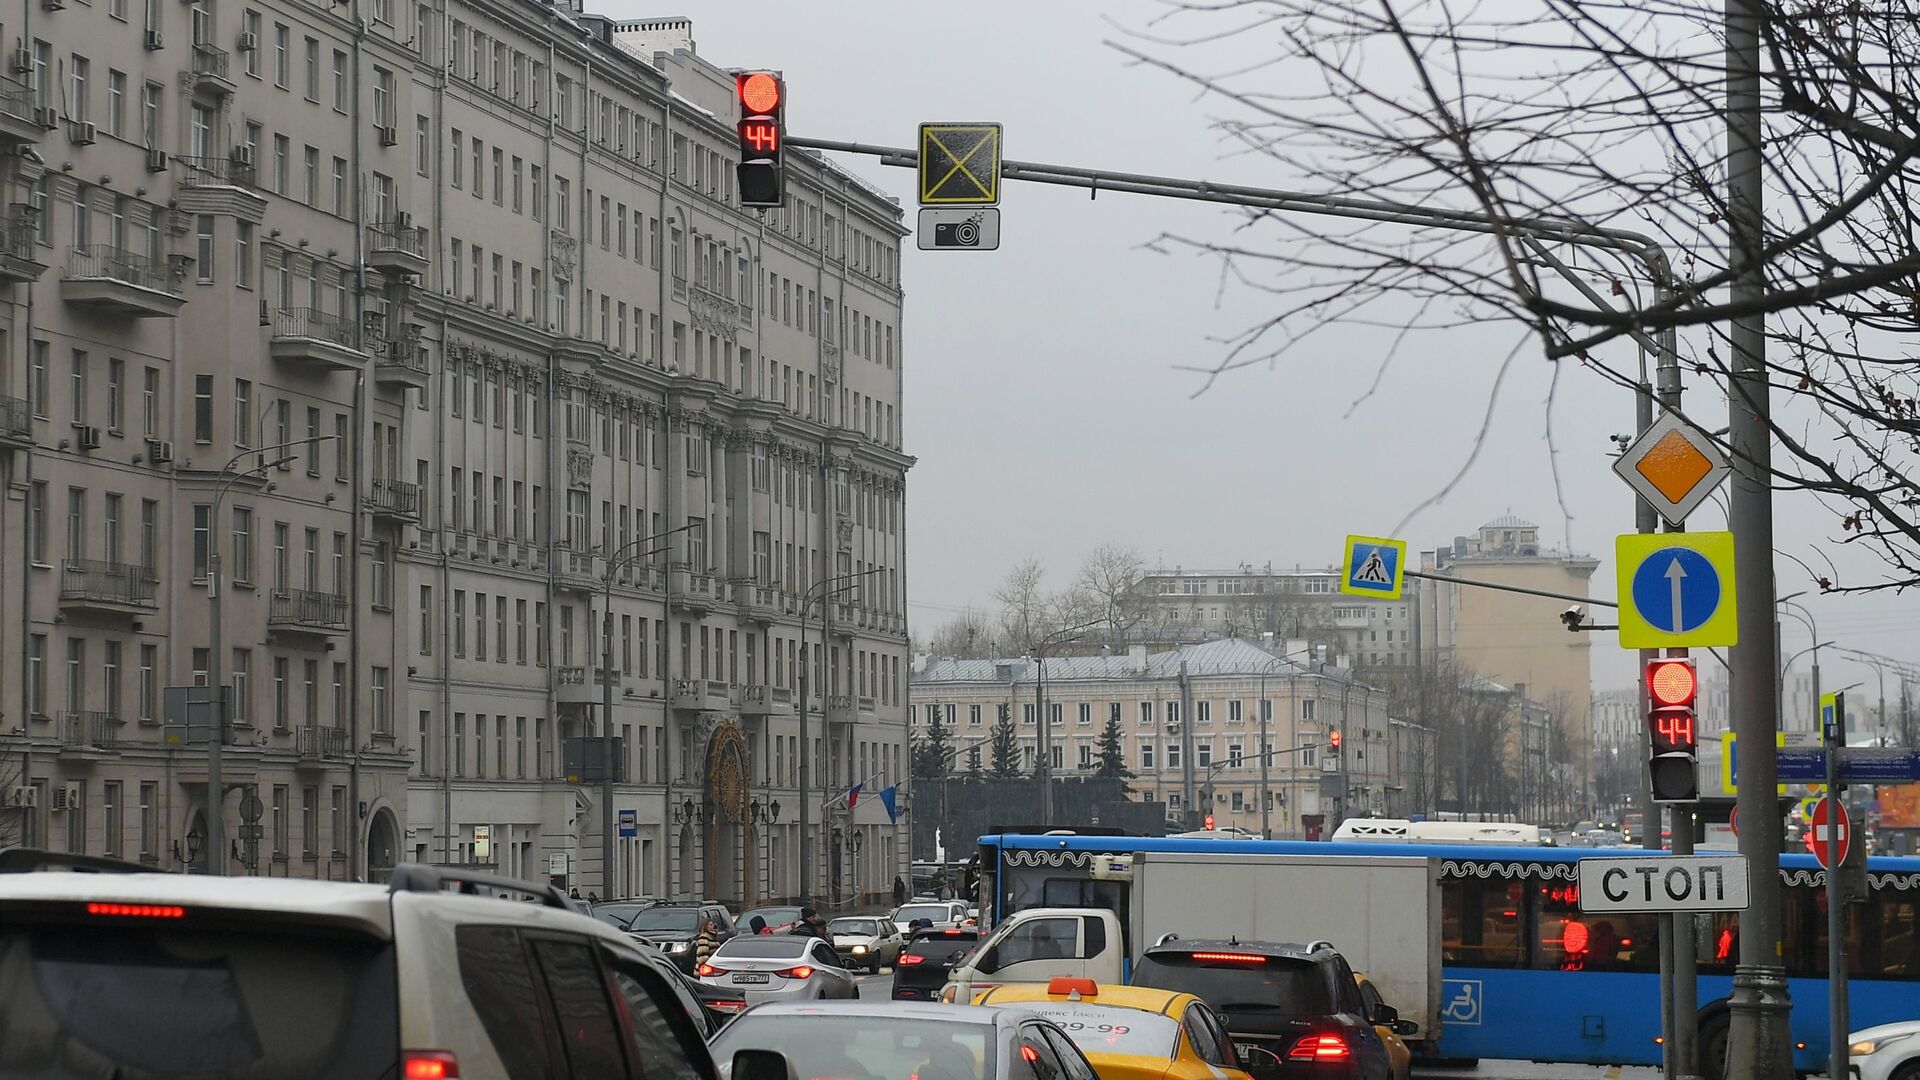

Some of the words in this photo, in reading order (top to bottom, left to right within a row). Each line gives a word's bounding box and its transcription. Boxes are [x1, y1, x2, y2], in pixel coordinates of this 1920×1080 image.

[747, 126, 775, 151] 44
[1658, 718, 1691, 745] 44
[1602, 866, 1724, 903] СТОП
